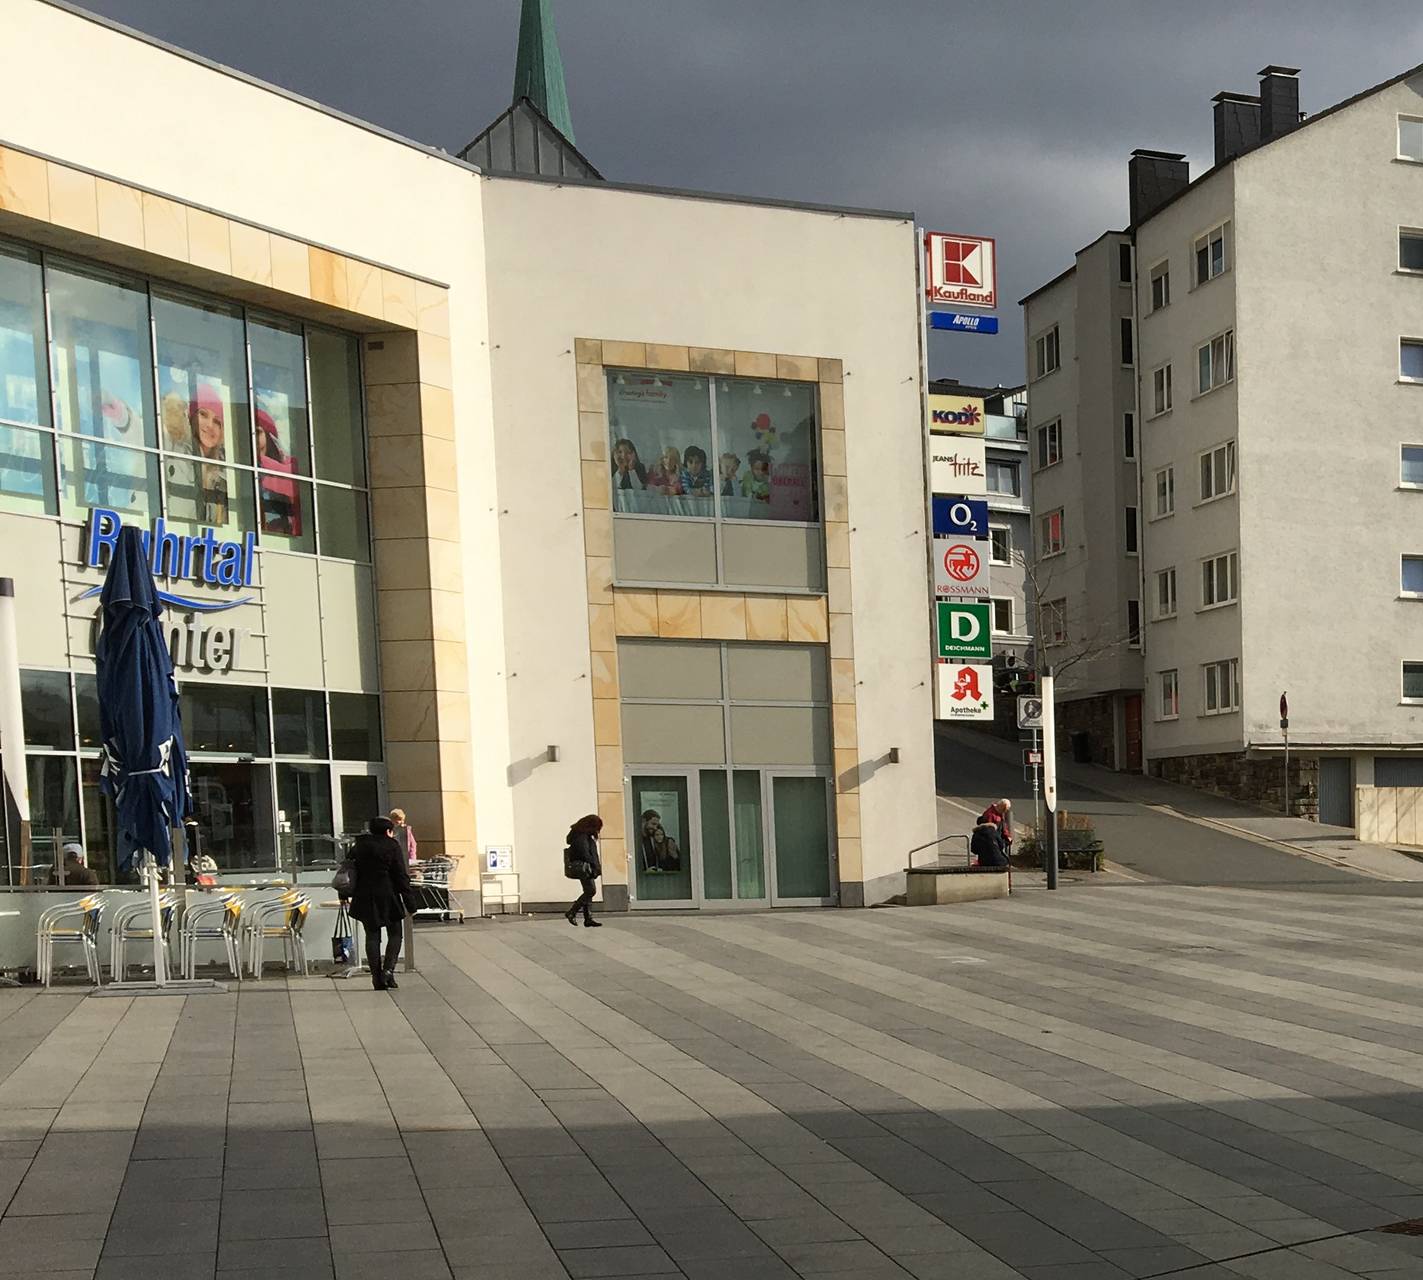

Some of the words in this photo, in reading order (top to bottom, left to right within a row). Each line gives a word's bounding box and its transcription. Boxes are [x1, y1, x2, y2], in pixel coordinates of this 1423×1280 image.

[933, 286, 993, 303] Kaufland
[949, 453, 984, 478] fritz
[936, 584, 989, 594] ROSSMANN
[950, 611, 980, 642] D
[951, 706, 982, 714] Apotheke
